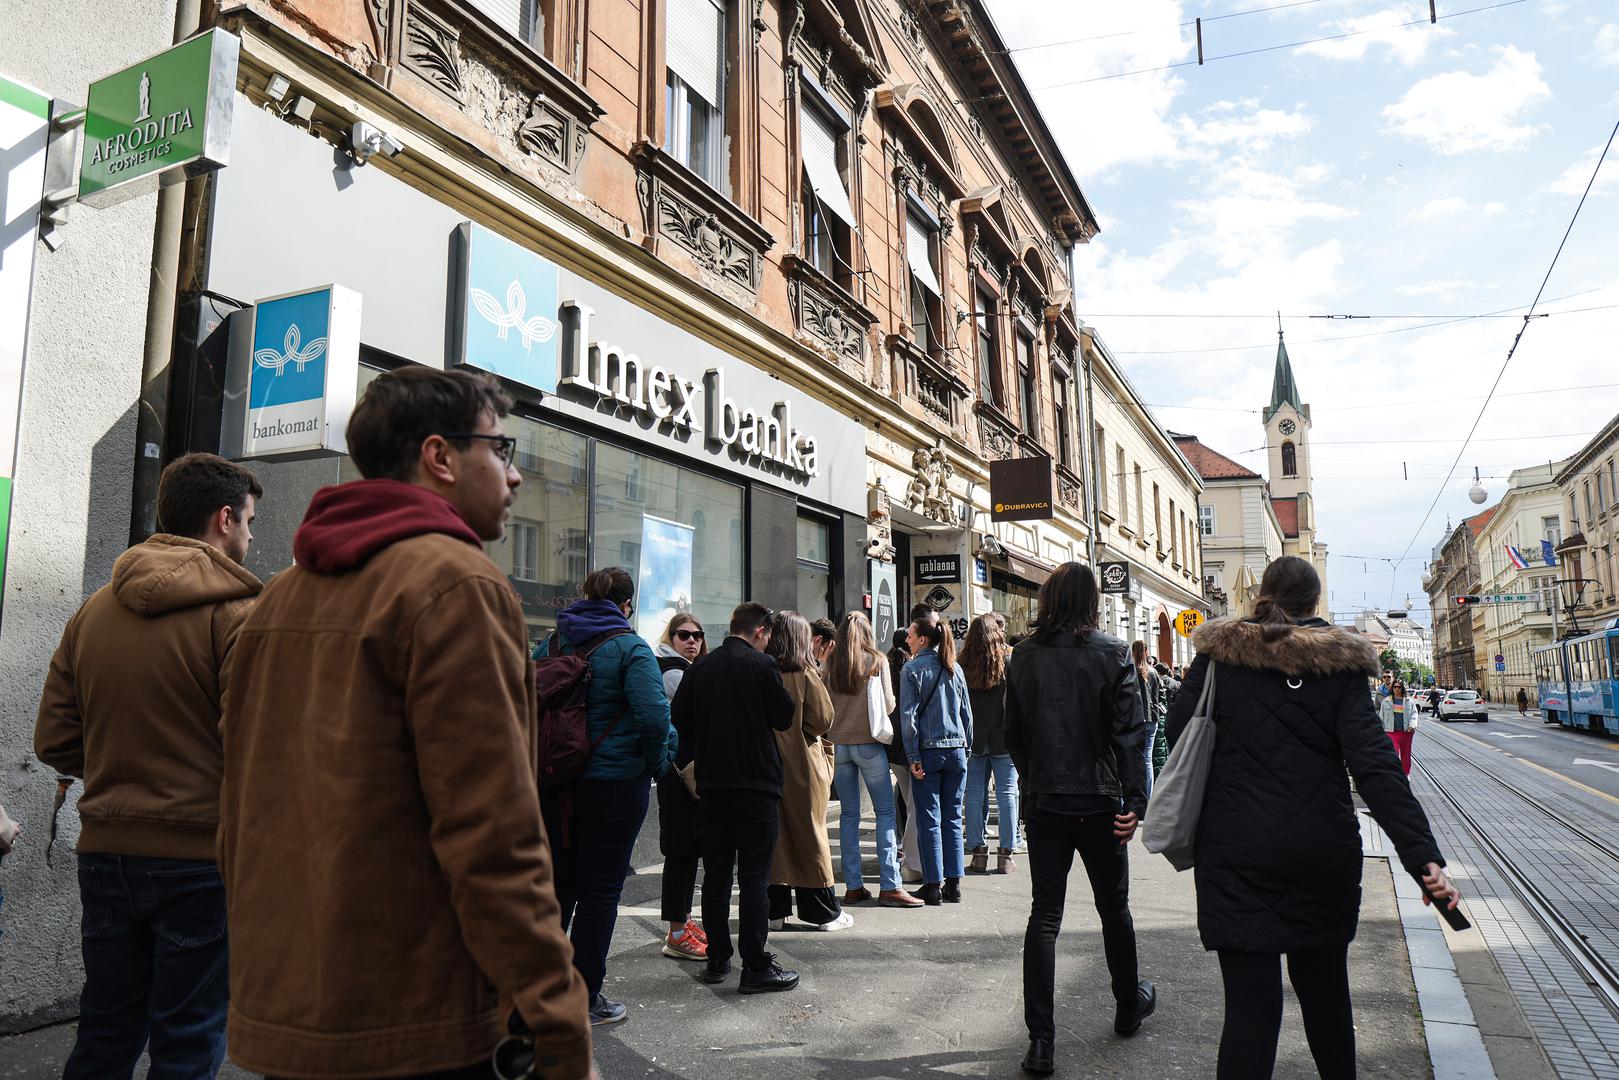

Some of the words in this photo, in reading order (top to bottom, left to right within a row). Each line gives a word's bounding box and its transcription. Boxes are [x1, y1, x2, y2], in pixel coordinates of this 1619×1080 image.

[91, 108, 193, 165] AFRODITA
[108, 141, 171, 174] COSMETICS
[558, 300, 703, 432] Imex
[704, 365, 820, 479] banka
[253, 416, 318, 439] bankomat
[1004, 502, 1048, 511] DUBRAVICA
